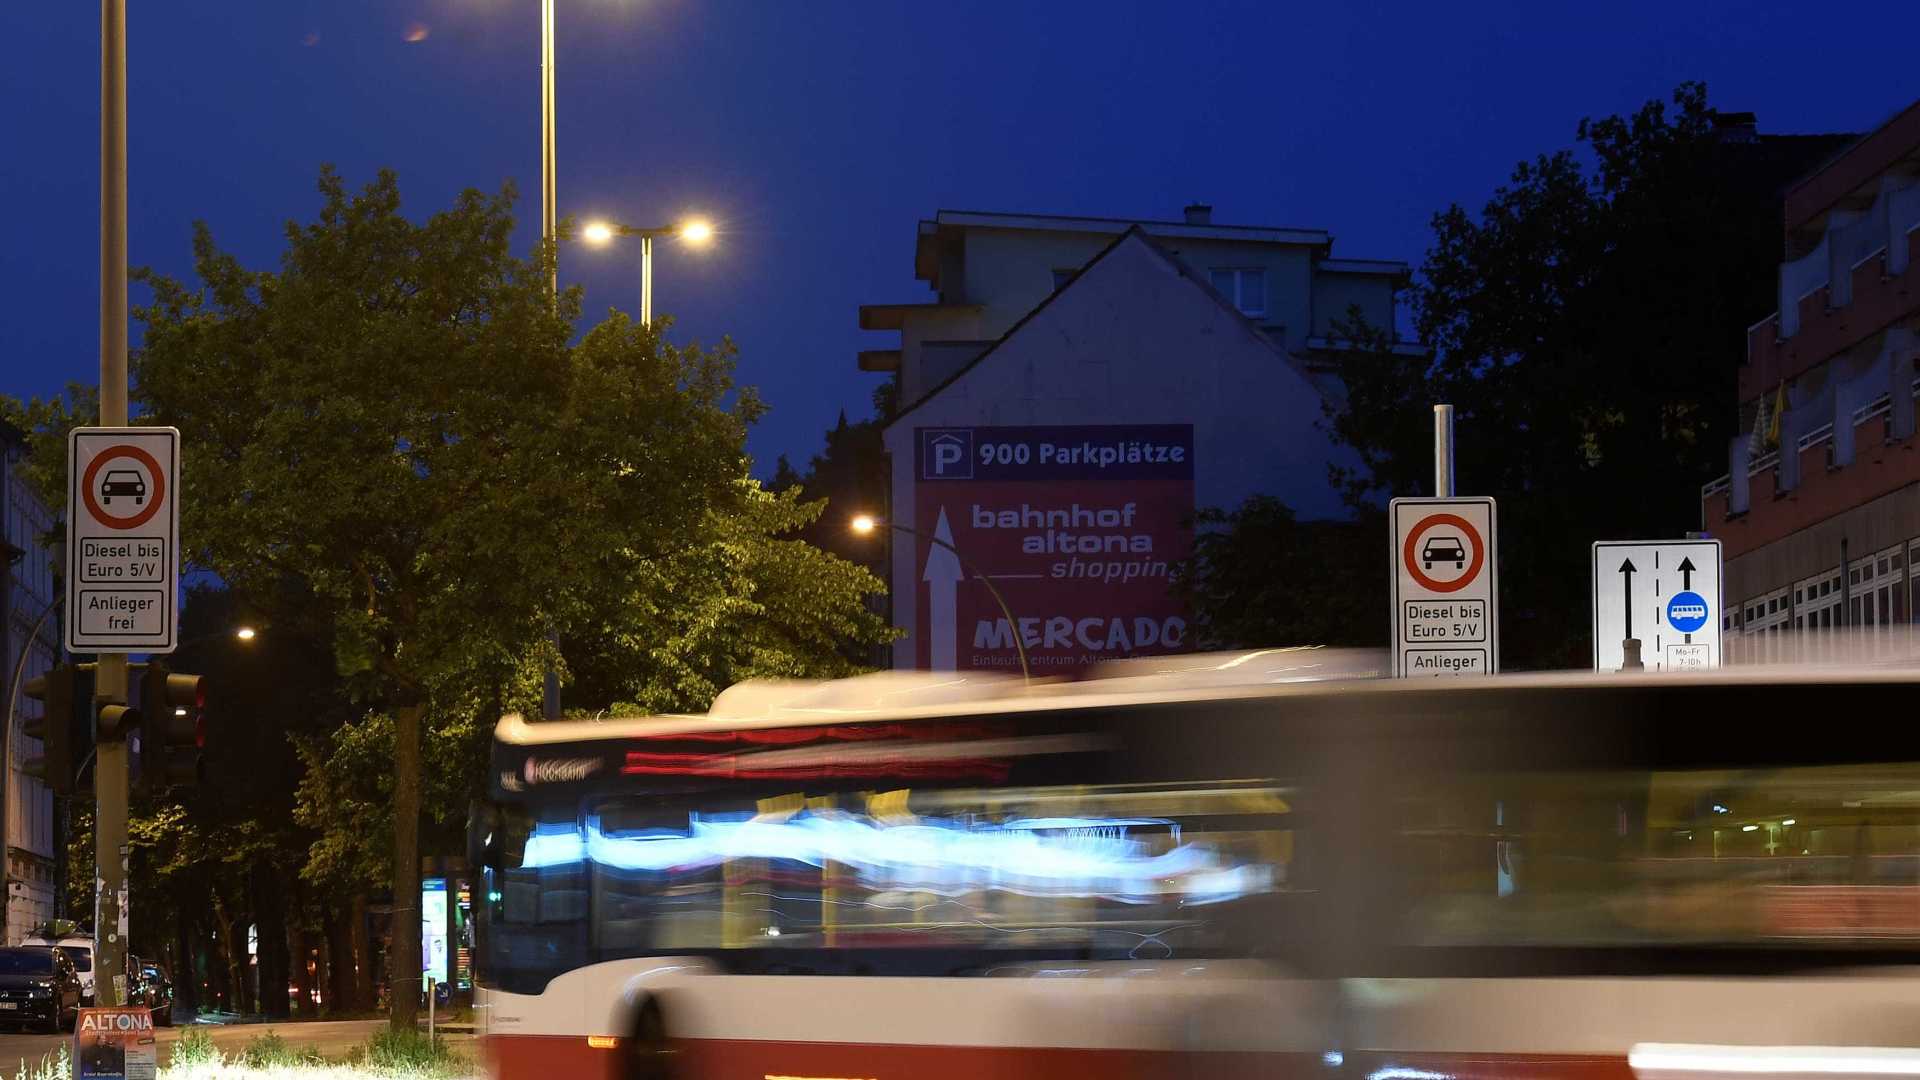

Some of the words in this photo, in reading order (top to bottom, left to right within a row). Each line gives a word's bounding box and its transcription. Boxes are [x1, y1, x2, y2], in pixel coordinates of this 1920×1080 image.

[980, 444, 1030, 465] 900
[1039, 442, 1185, 468] Parkplätze
[972, 502, 1137, 529] bahnhof
[1022, 530, 1153, 553] altona
[84, 543, 131, 557] Diesel
[137, 543, 160, 557] bis
[88, 563, 123, 577] Euro
[130, 563, 156, 577] 5/V
[88, 596, 154, 613] Anlieger
[1408, 606, 1454, 619] Diesel
[1459, 605, 1481, 619] bis
[108, 616, 135, 630] frei
[973, 616, 1186, 651] MERCADO
[1412, 625, 1446, 638] Euro
[1453, 624, 1478, 637] 5/V
[1675, 648, 1701, 656] Mo-Fr
[972, 654, 1075, 666] Einkaufsentrum
[1414, 655, 1477, 671] Anlieger
[81, 1014, 153, 1030] ALTONA
